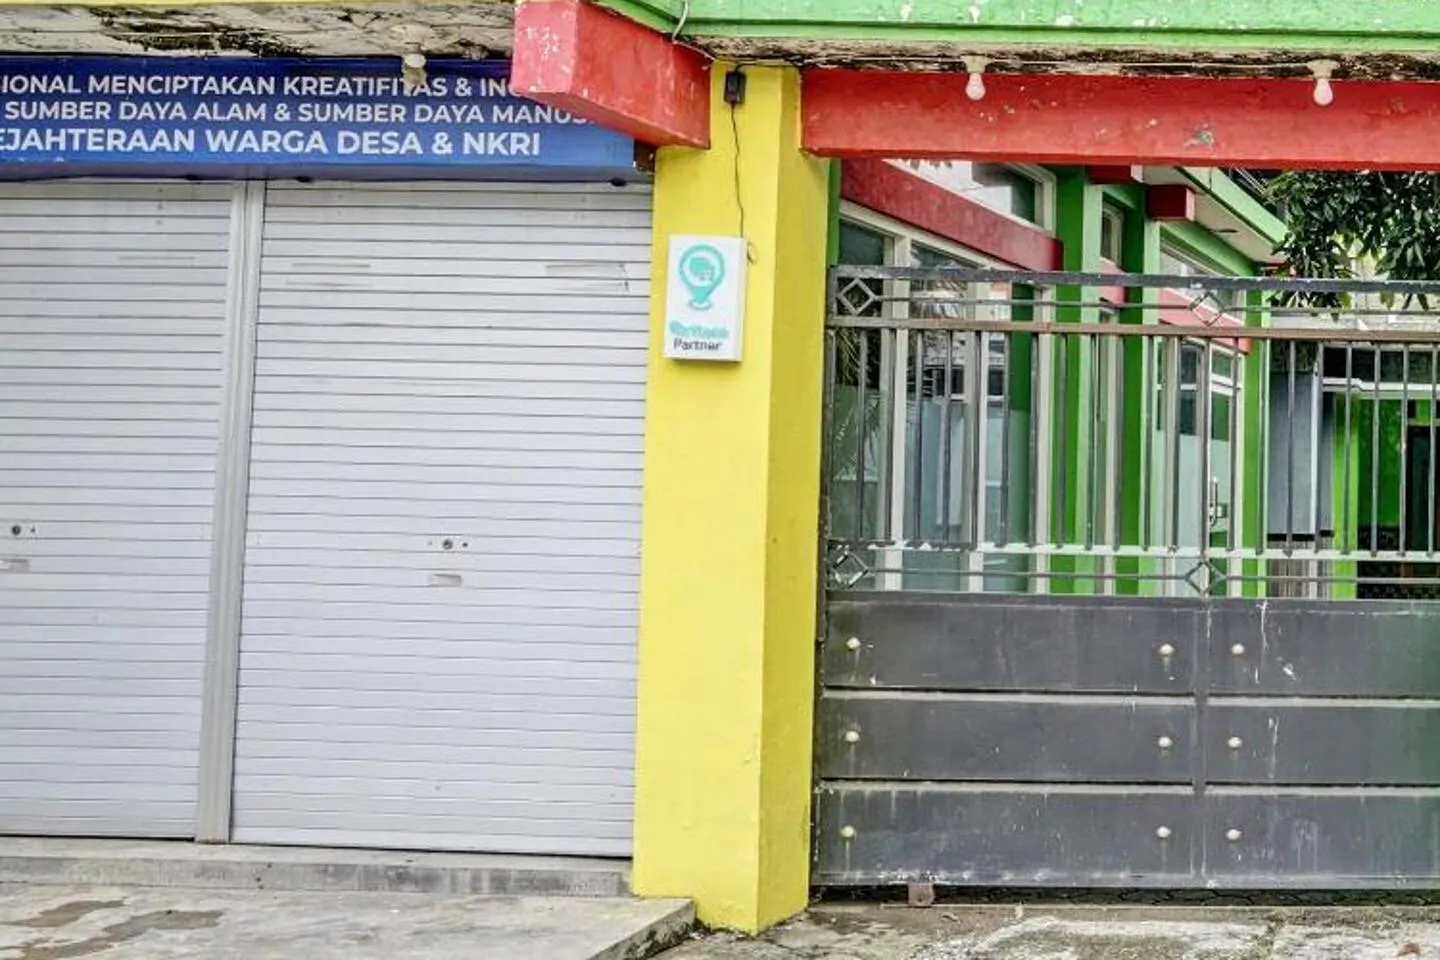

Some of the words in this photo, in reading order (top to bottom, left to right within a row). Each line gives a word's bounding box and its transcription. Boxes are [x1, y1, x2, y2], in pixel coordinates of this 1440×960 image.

[2, 74, 81, 94] IONAL
[88, 74, 275, 96] MENCIPTAKAN
[455, 77, 472, 97] &
[4, 100, 111, 120] SUMBER
[119, 101, 187, 121] DAYA
[193, 102, 266, 122] ALAM
[273, 103, 290, 122] &
[297, 103, 407, 123] SUMBER
[414, 104, 485, 124] DAYA
[492, 105, 596, 124] MANU
[204, 129, 328, 155] WARGA
[337, 131, 424, 155] DESA
[432, 131, 454, 155] &
[463, 132, 540, 156] NKRI
[673, 338, 723, 351] Partner
